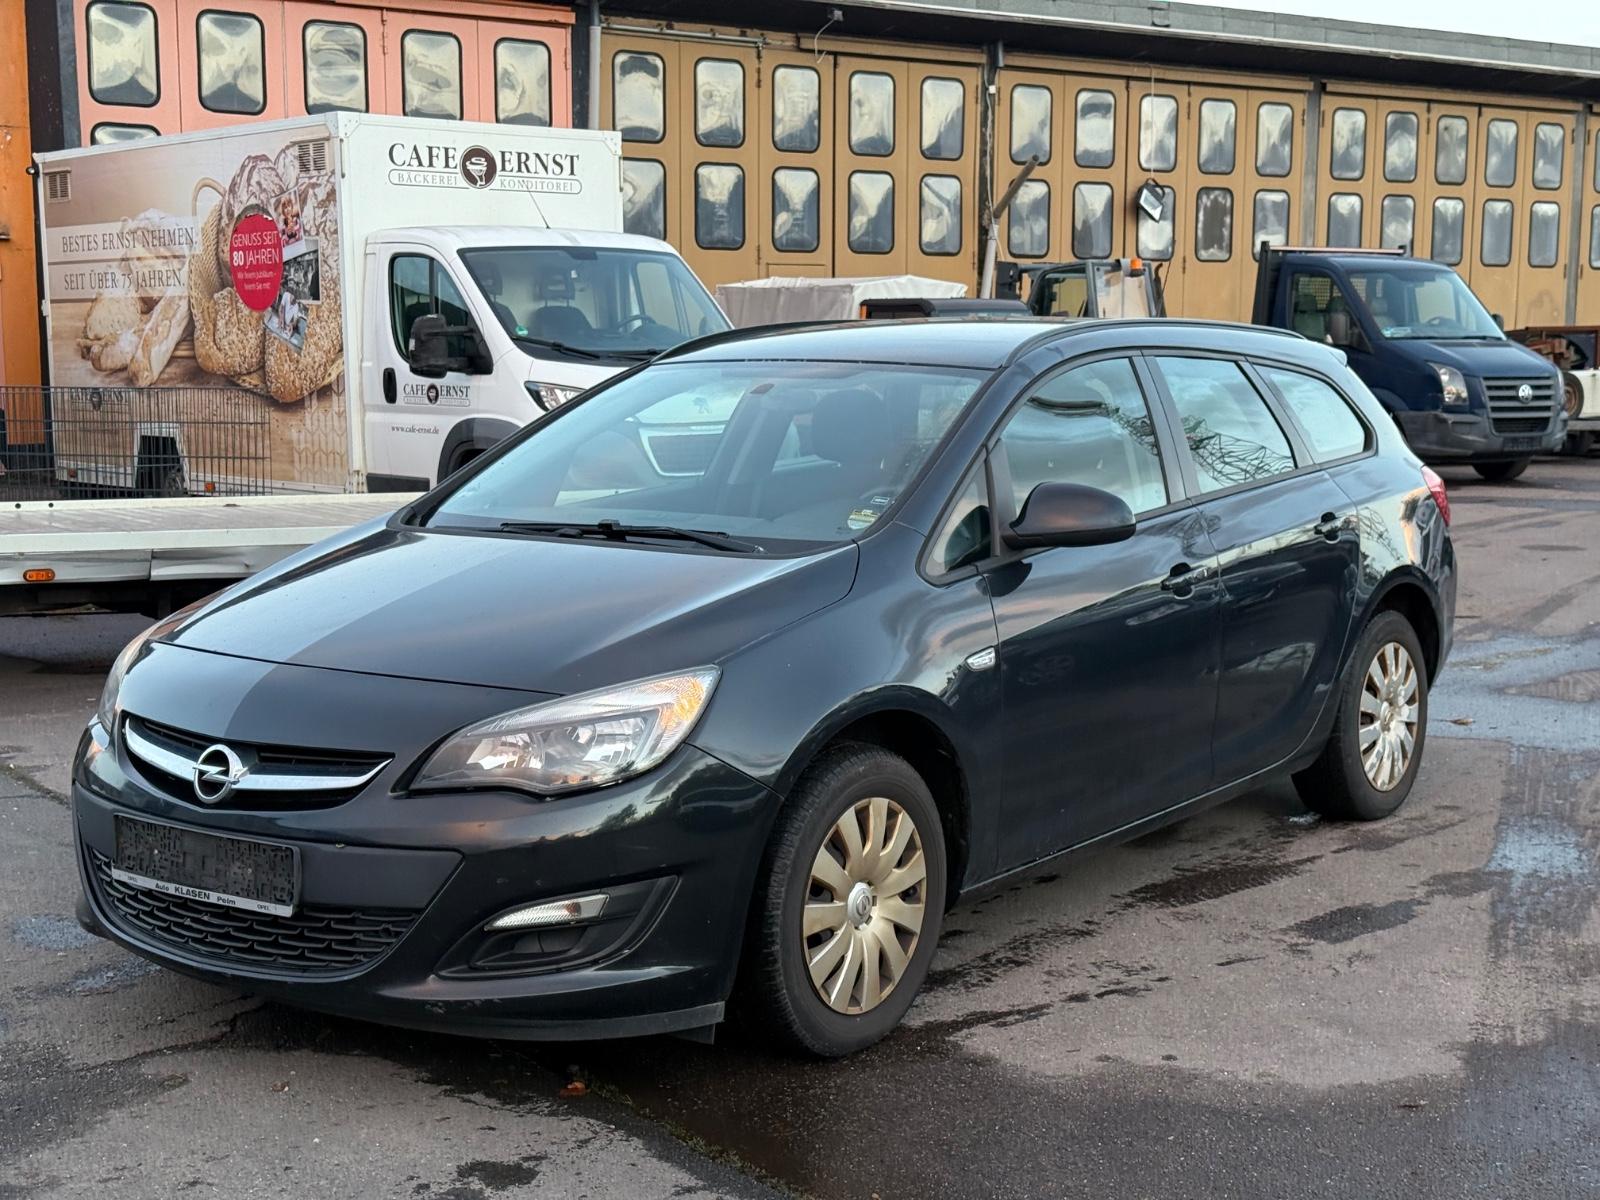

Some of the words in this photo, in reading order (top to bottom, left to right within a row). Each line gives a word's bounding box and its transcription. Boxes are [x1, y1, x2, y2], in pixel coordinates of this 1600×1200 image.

[388, 143, 458, 169] CAFE
[498, 150, 580, 176] ERNST
[398, 172, 457, 186] BÄCKEREI
[500, 178, 574, 192] KONDITOREI
[62, 234, 99, 253] BESTES
[102, 231, 139, 250] ERNST
[141, 227, 198, 247] NEHMEN.
[232, 232, 262, 247] GENUSS
[262, 230, 278, 245] SEIT
[233, 250, 244, 267] 80
[245, 248, 280, 269] JAHREN
[64, 273, 86, 290] SEIT
[89, 269, 118, 289] ÜBER
[121, 273, 132, 289] 75
[135, 268, 186, 293] JAHREN.
[403, 383, 427, 396] CAFE
[440, 384, 471, 397] ERNST
[155, 882, 170, 892] Auto
[174, 886, 211, 900] KLASEN
